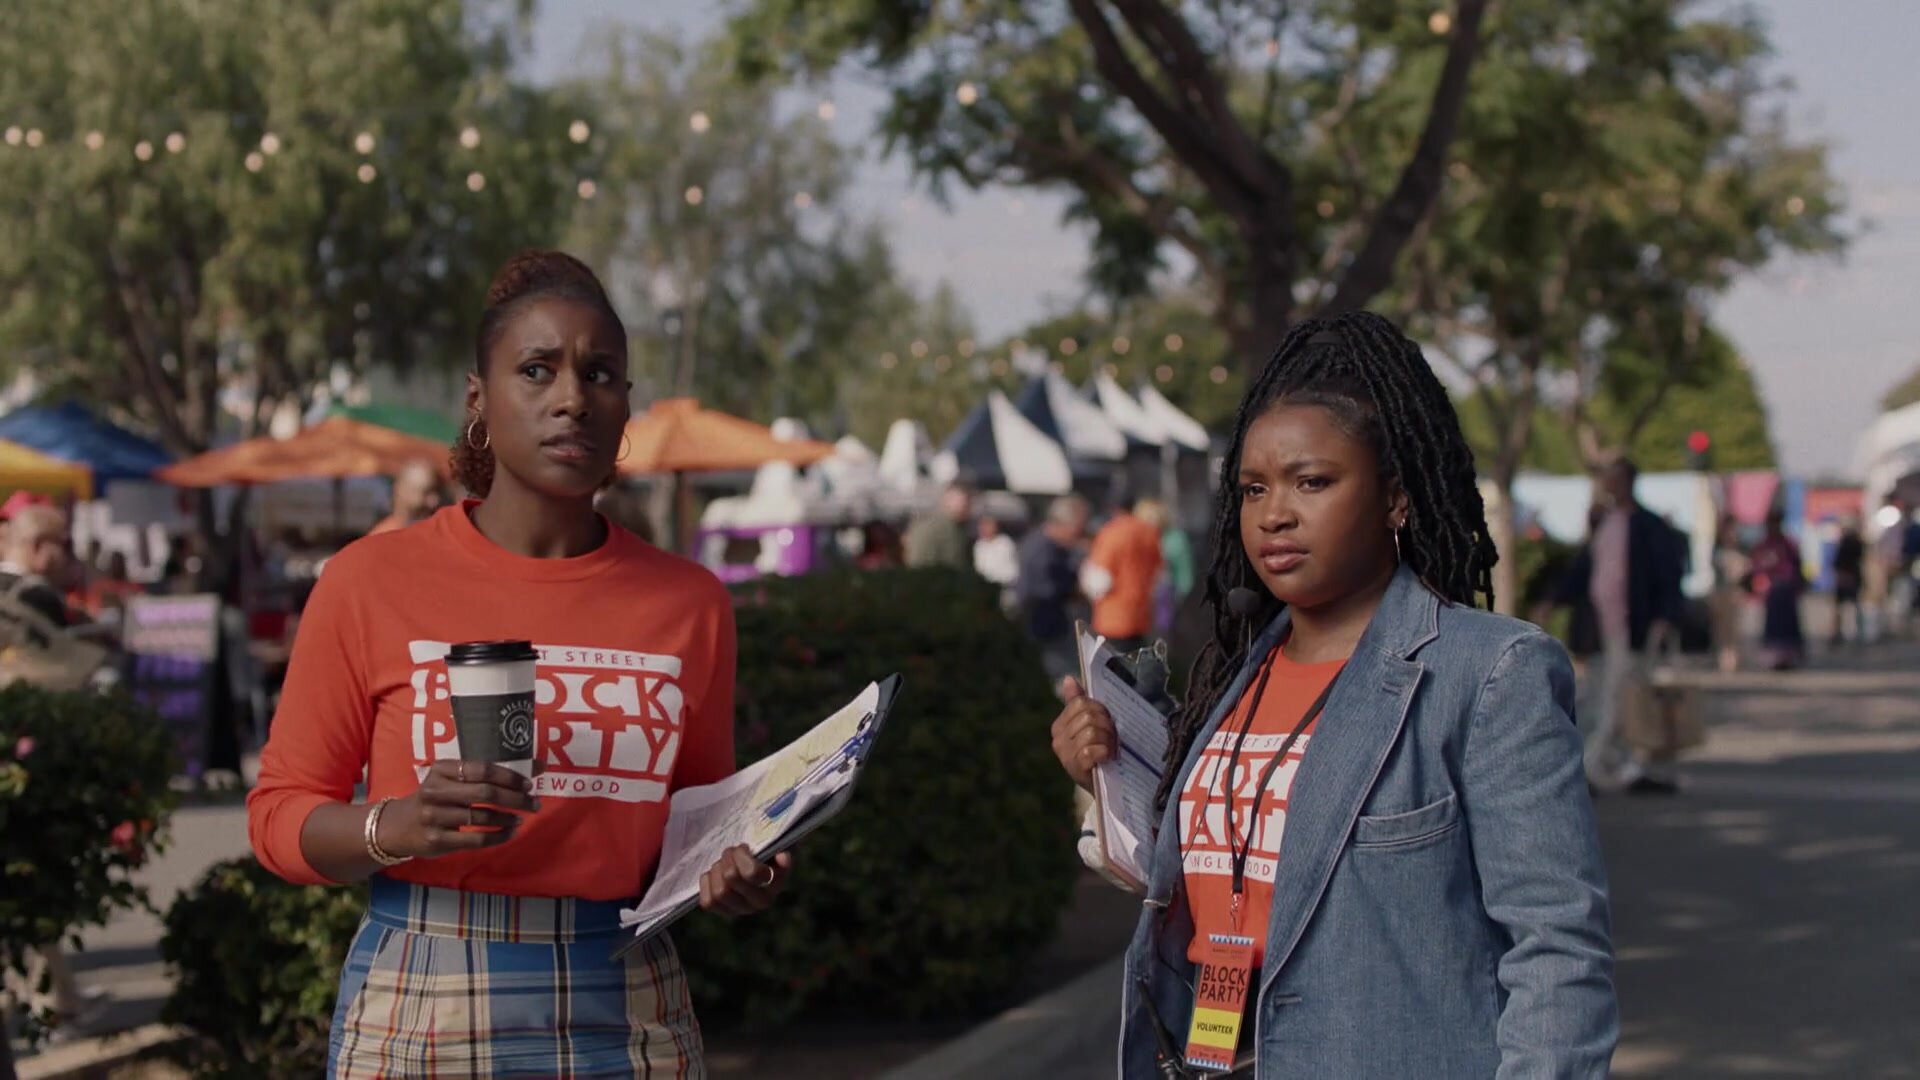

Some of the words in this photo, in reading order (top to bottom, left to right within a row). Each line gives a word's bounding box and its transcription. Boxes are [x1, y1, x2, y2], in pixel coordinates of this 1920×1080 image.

[565, 651, 647, 666] STREET
[425, 668, 680, 726] BOCK
[425, 714, 679, 777] PRTY
[1190, 856, 1270, 875] INGLEOOD
[1203, 965, 1246, 986] BLOCK
[1200, 983, 1244, 1004] PARTY
[1197, 1022, 1233, 1035] VOLUNTEER
